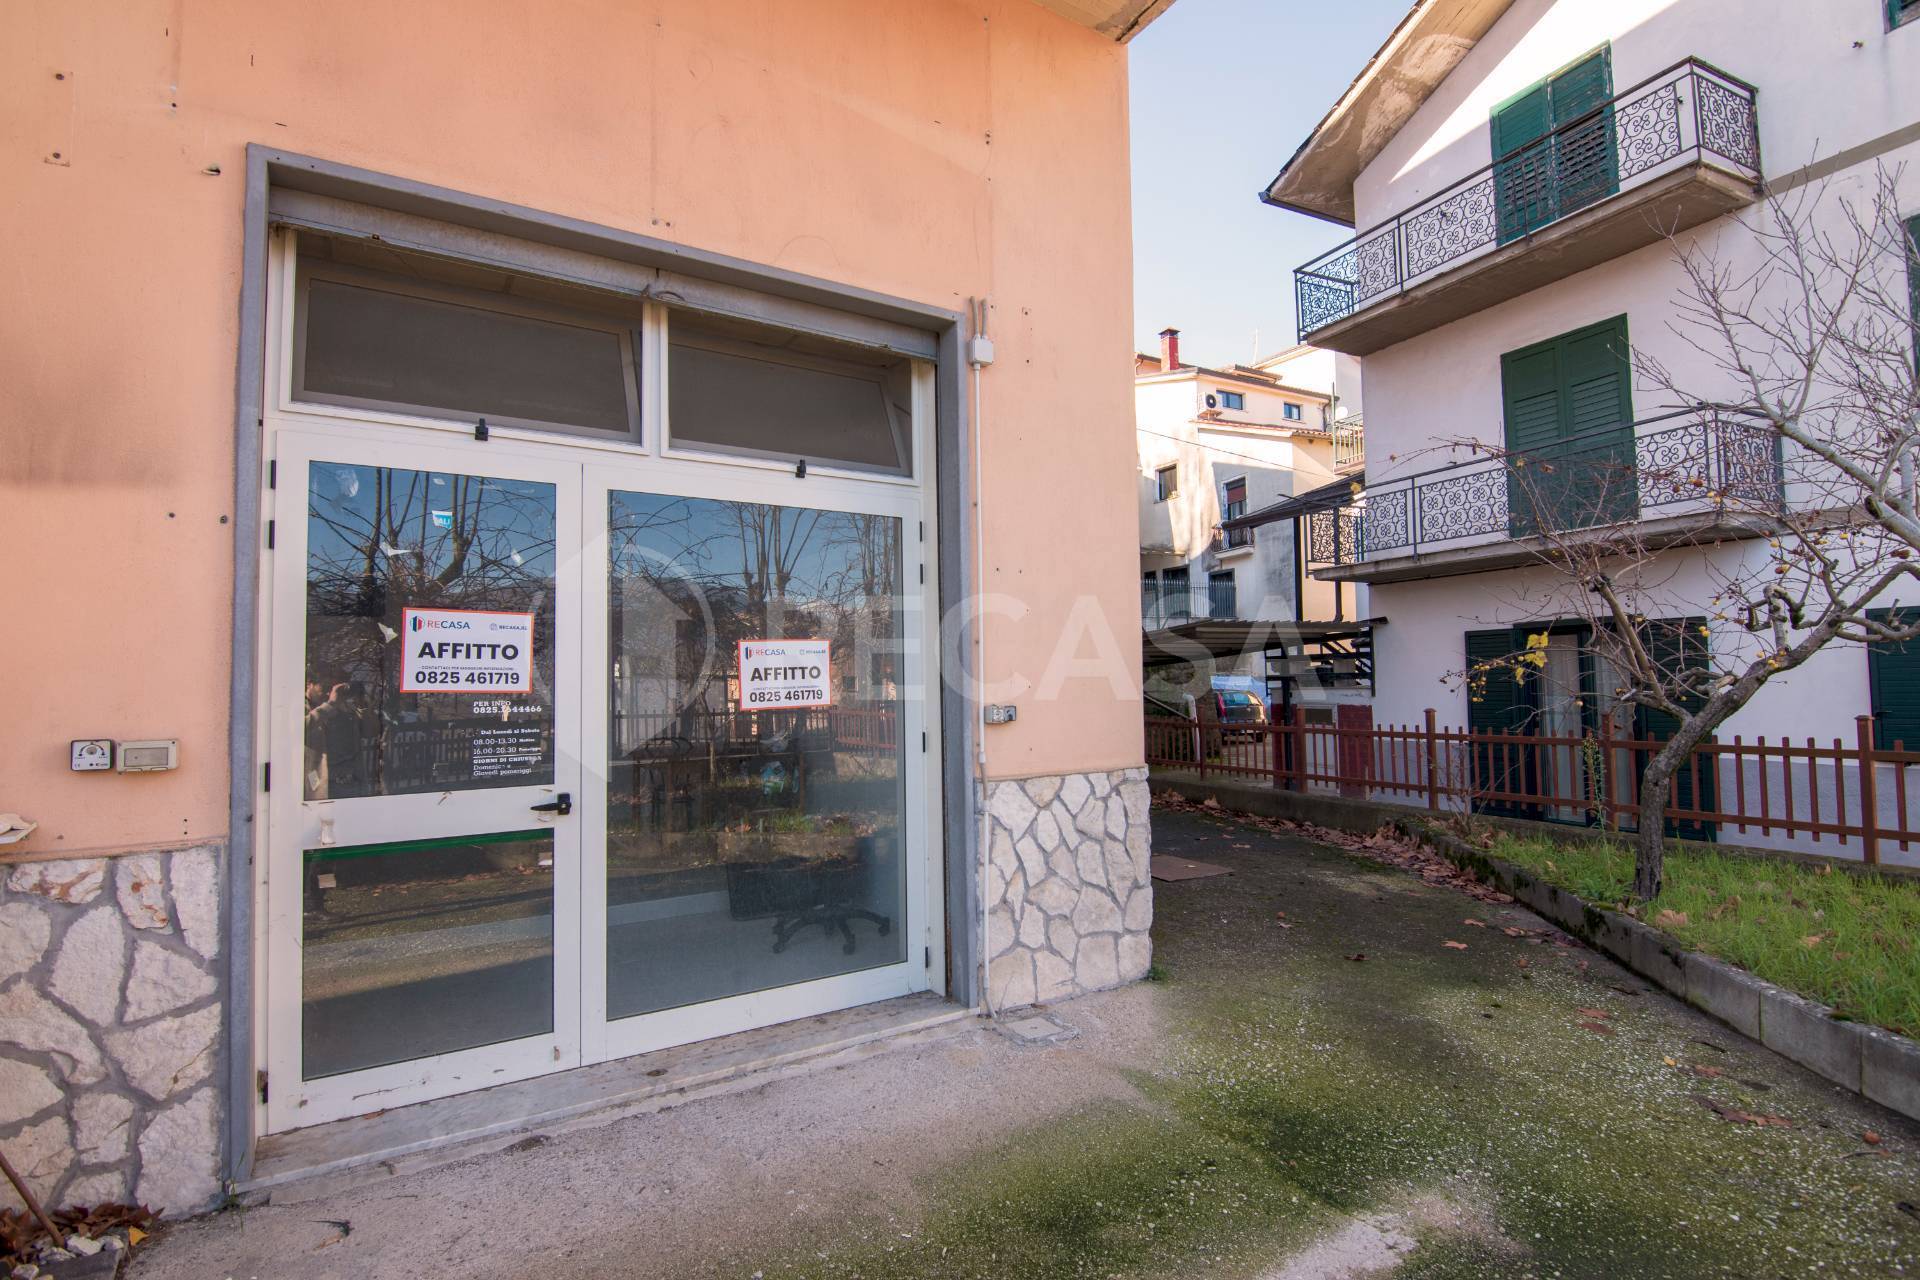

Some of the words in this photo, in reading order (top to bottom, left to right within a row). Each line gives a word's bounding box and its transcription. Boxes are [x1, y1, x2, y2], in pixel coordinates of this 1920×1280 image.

[427, 620, 471, 630] RECASA
[417, 642, 519, 660] AFFITTO
[415, 671, 460, 684] 0825
[465, 672, 520, 684] 461719
[750, 666, 821, 681] AFFITTO
[749, 691, 781, 702] 0825
[784, 689, 823, 700] 461719
